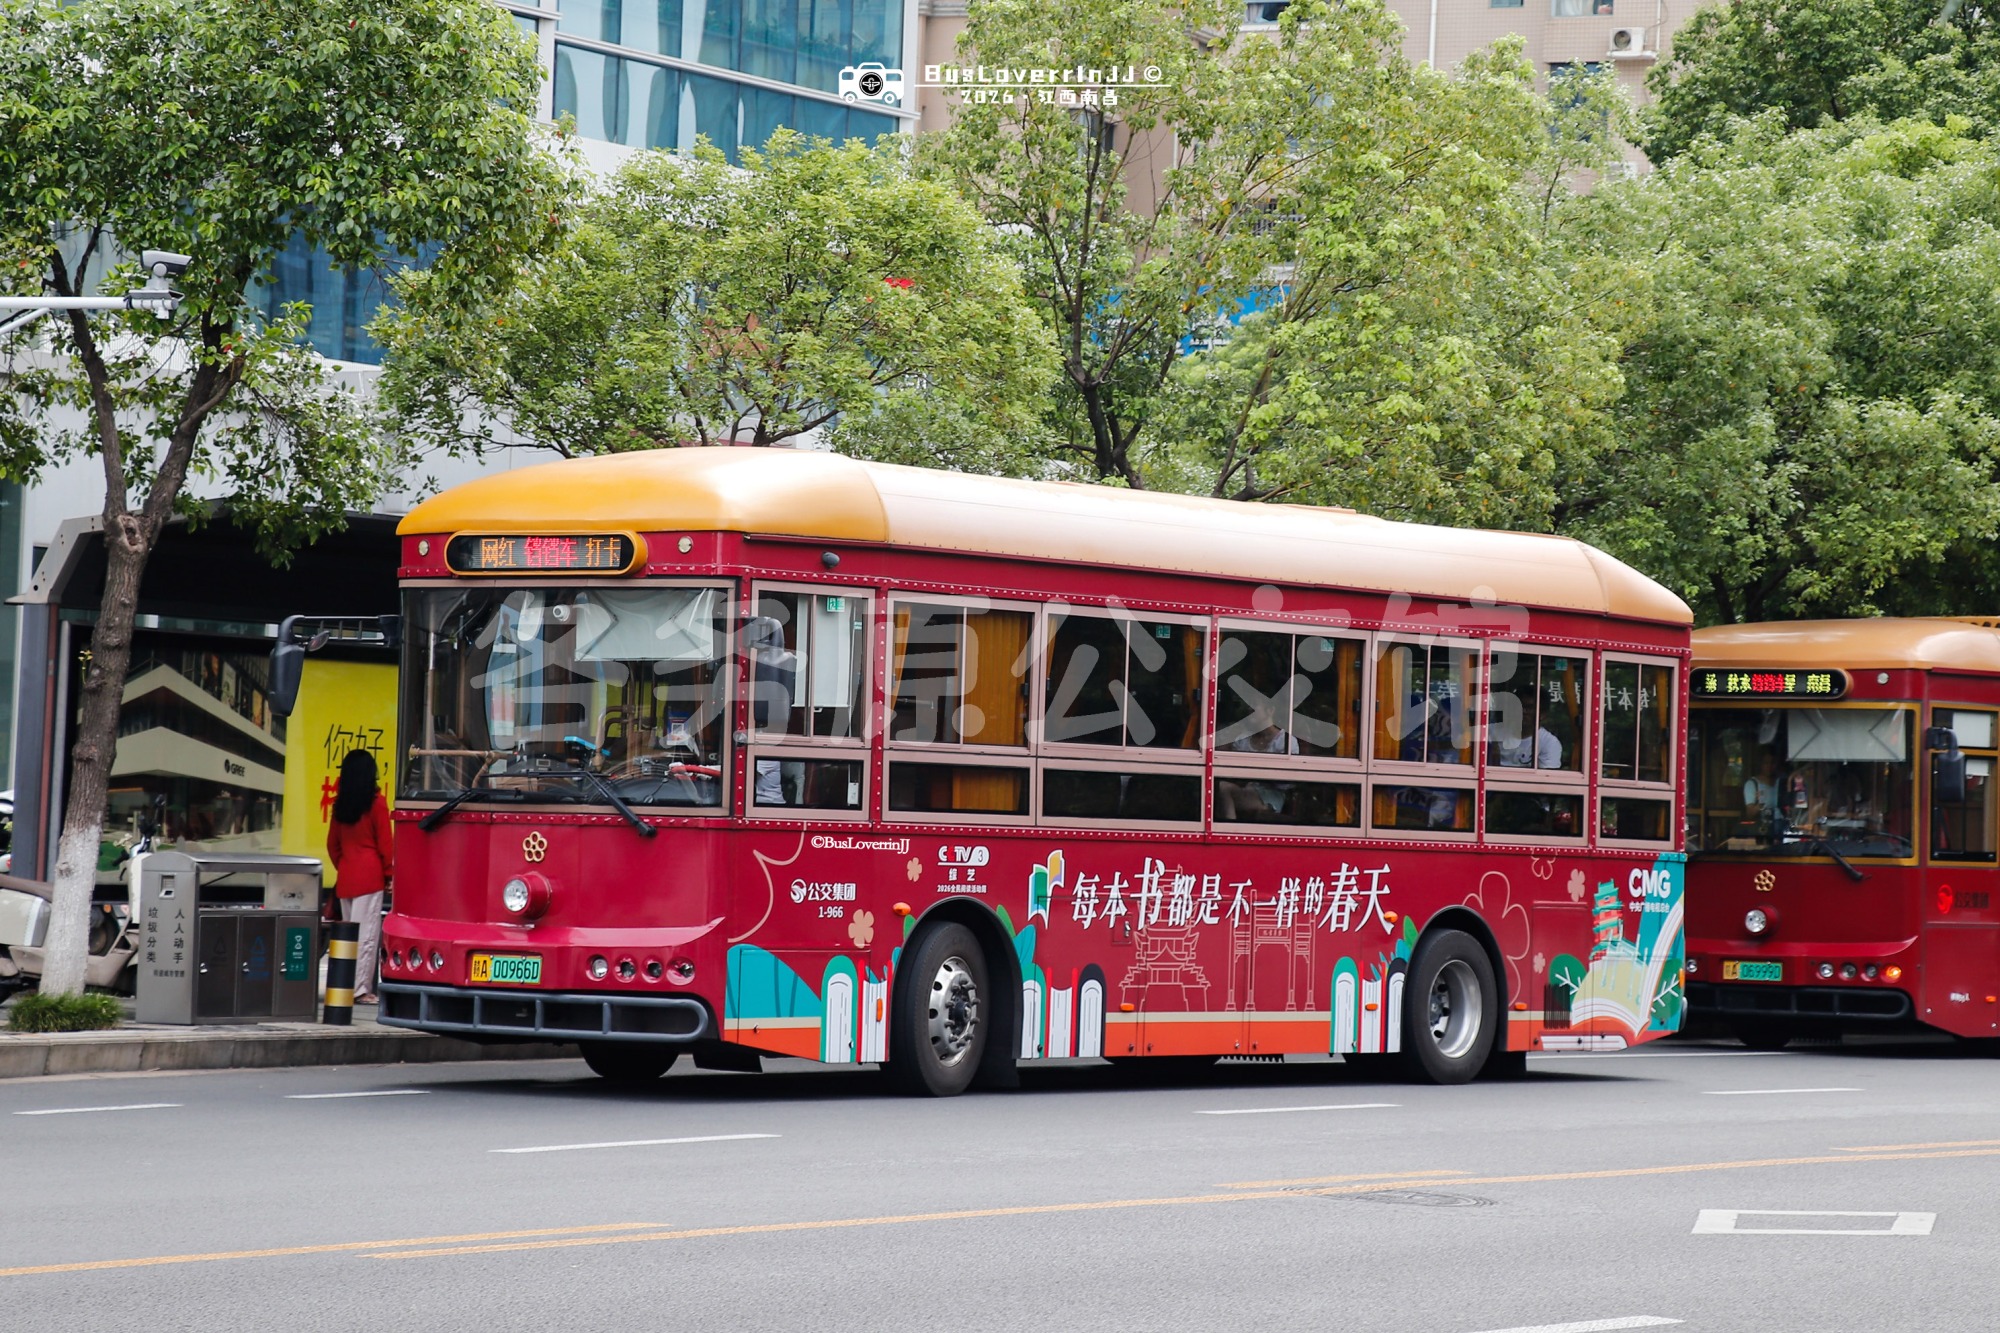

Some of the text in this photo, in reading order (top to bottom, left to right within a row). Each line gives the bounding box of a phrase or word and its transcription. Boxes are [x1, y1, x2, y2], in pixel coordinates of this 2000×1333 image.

[480, 537, 517, 568] 网红
[585, 537, 621, 567] 打卡
[230, 763, 245, 777] GREE
[949, 868, 976, 881] 综艺
[1628, 868, 1671, 899] CMG
[808, 882, 856, 901] 公交集团
[1070, 857, 1395, 936] 每本书都是不一样的春天
[818, 906, 844, 919] 1-966
[146, 907, 159, 963] 垃圾分类
[173, 908, 185, 964] 人人动手
